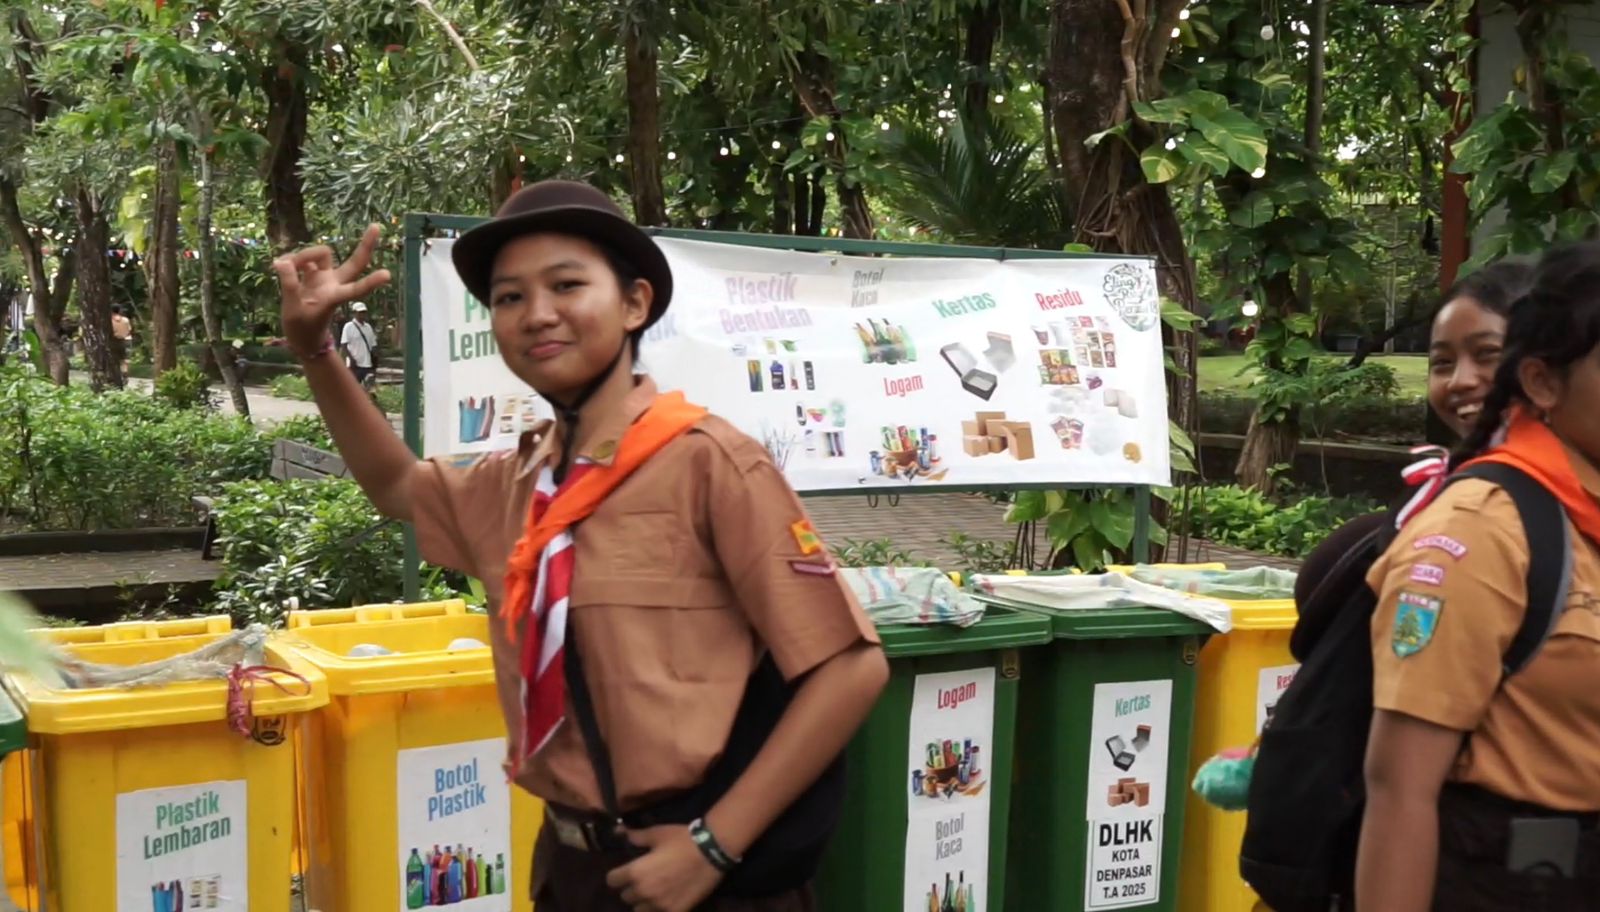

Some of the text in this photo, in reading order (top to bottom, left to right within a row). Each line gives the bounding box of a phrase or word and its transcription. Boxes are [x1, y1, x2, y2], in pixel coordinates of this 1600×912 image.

[725, 272, 798, 304] Plastik
[1035, 288, 1084, 311] Residu
[932, 292, 997, 318] Kertas
[719, 306, 813, 335] Bentukan
[883, 375, 924, 397] Logam
[937, 682, 976, 710] Logam
[1115, 694, 1151, 718] Kertas
[435, 757, 477, 793] Botol
[156, 791, 219, 830] Plastik
[428, 782, 486, 821] Plastik
[144, 816, 231, 860] Lembaran
[935, 812, 965, 841] Botol
[1099, 819, 1153, 847] DLHK
[935, 837, 962, 861] Kaca
[1112, 848, 1140, 862] KOTA
[1096, 865, 1152, 882] DENPASAR
[1103, 882, 1146, 899] T.A 2025
